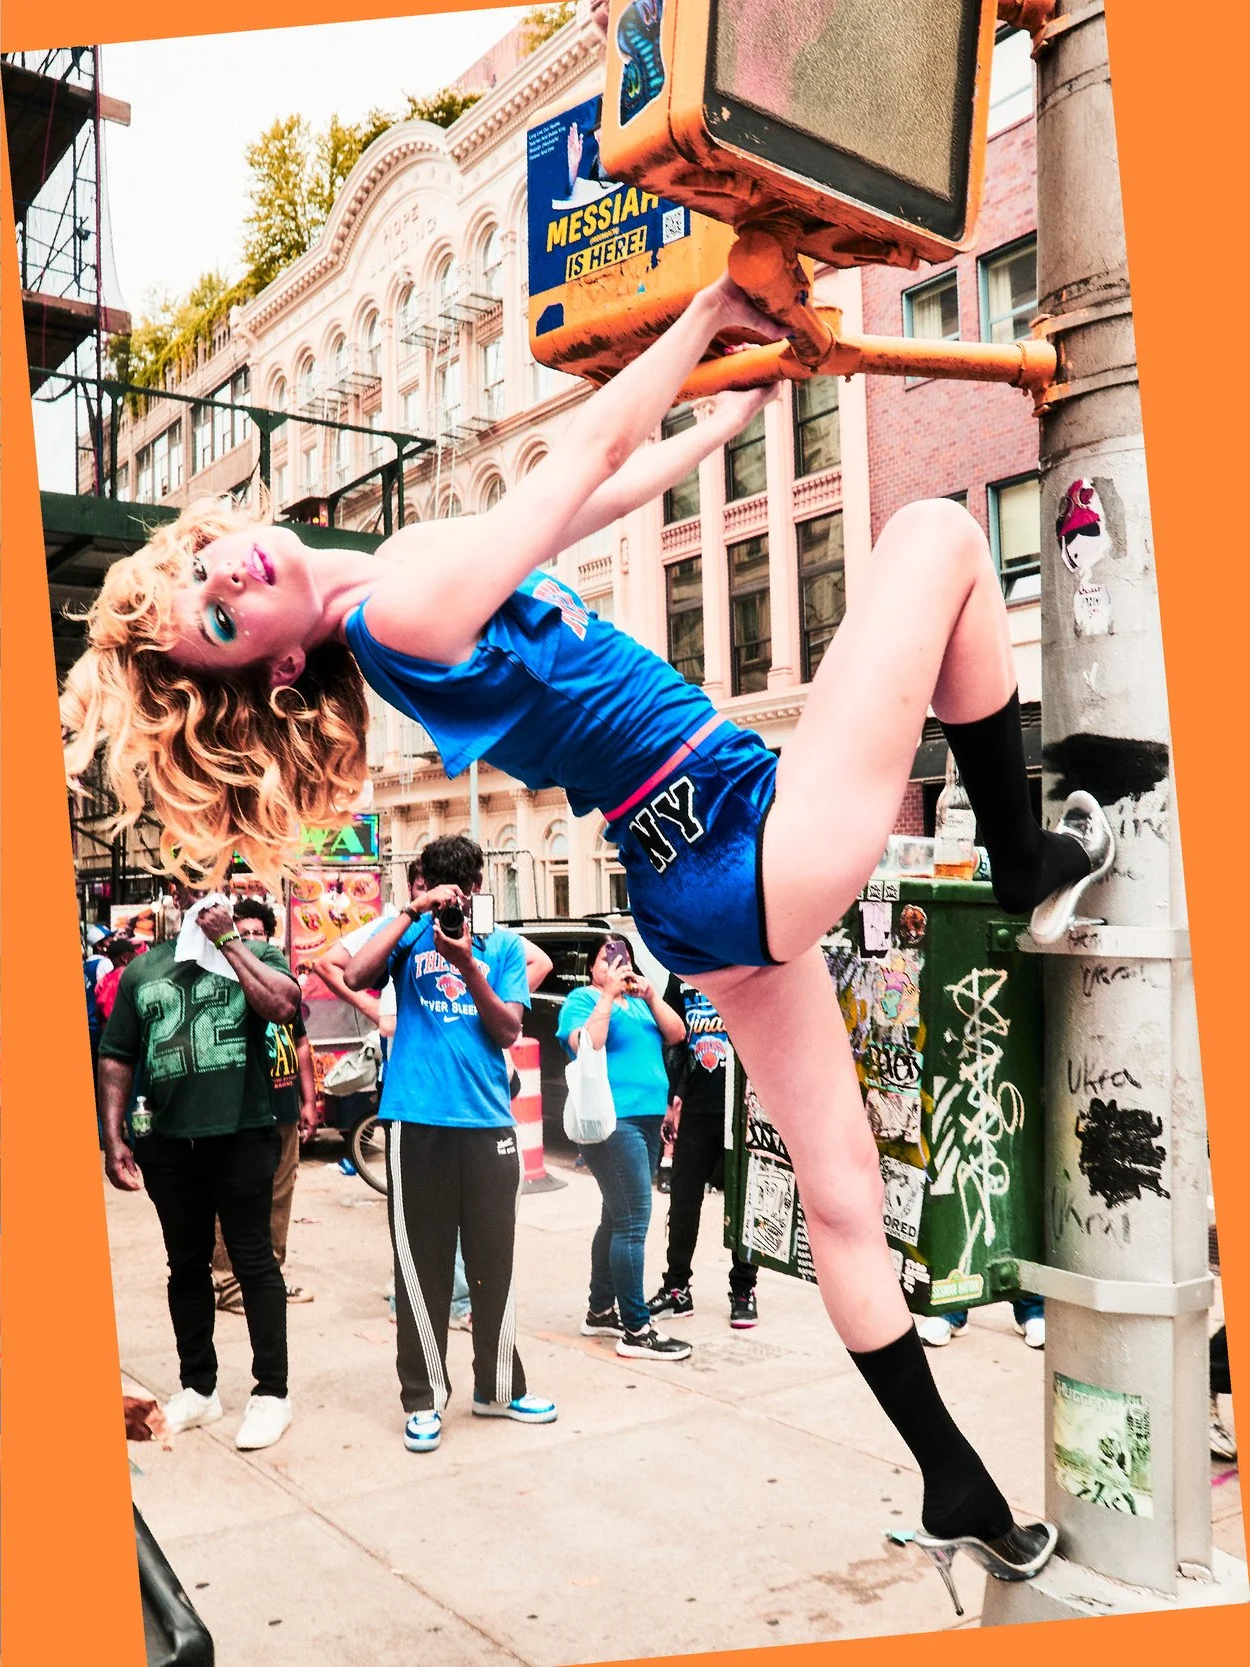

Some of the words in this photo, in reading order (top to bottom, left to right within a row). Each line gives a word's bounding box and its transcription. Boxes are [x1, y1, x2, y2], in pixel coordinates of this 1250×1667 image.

[546, 187, 659, 252] MESSIAH
[567, 252, 585, 279] IS
[590, 229, 646, 270] HERE!
[629, 775, 704, 874] NY
[135, 974, 248, 1085] 22
[685, 1008, 727, 1043] Fina
